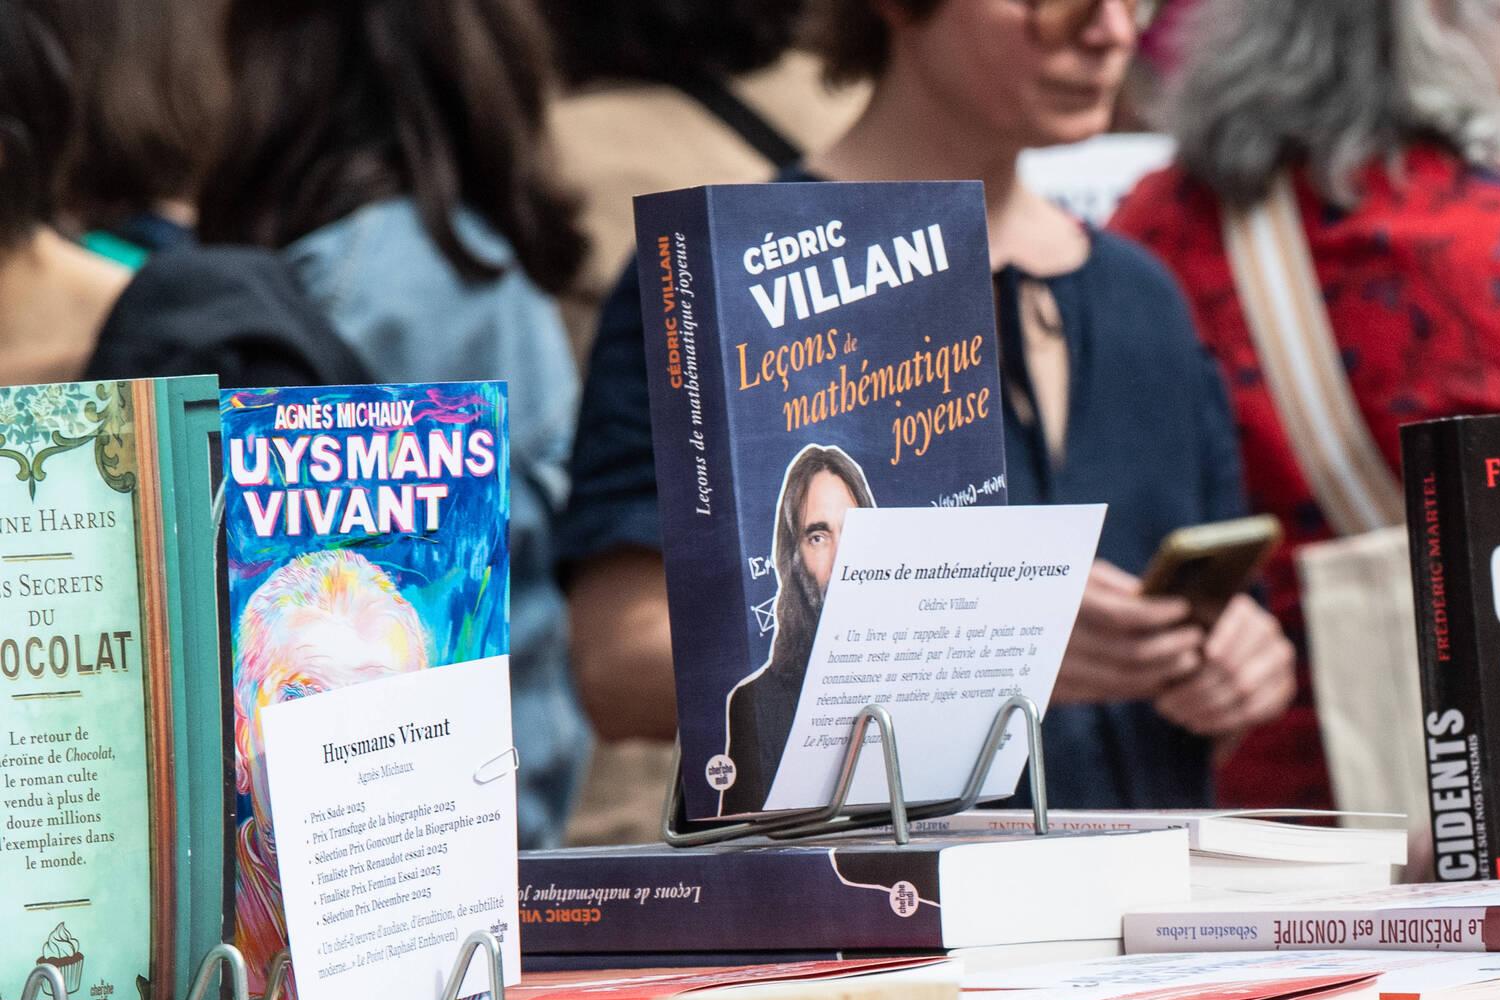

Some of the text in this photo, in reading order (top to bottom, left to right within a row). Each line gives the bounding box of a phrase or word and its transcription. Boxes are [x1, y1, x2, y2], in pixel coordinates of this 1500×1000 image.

[742, 219, 846, 275] CÉDRIC
[750, 223, 950, 328] VILLANI
[658, 236, 683, 389] CÉDRIC VILLANI
[736, 328, 858, 391] Leçons de
[675, 232, 712, 516] Leçons de mathématique joyeuse
[783, 334, 983, 431] mathématique
[275, 398, 415, 430] AGNÈS MICHAUX
[891, 388, 989, 465] joyeuse
[39, 509, 116, 531] HARRIS
[243, 484, 447, 537] VIVANT
[840, 561, 1070, 585] Leçons de mathématique joyeuse
[1423, 472, 1451, 662] FRÉDÉRIC MARTEL
[19, 574, 104, 596] SECRETS
[28, 609, 55, 626] DU
[9, 726, 89, 745] Le retour de
[322, 718, 450, 764] Huysmans Vivant
[48, 749, 62, 764] de
[66, 745, 116, 763] Chocolat,
[5, 767, 98, 788] le roman culte
[4, 787, 101, 810] vendu à plus de
[1426, 708, 1477, 880] CIDENTS
[434, 800, 456, 813] 2025
[6, 810, 101, 830] douze millions
[425, 815, 474, 835] Biographie
[476, 811, 501, 824] 2026
[0, 829, 115, 853] 'exemplaires dans
[26, 851, 86, 870] le monde.
[533, 882, 701, 907] Leçons de mathématique
[546, 908, 601, 926] CÉDRIC
[1352, 918, 1374, 936] est
[1156, 925, 1198, 939] Liebus
[1199, 924, 1258, 940] Sébastien
[1273, 919, 1347, 950] CONSTIPÉ
[1379, 918, 1462, 949] PRÉSIDENT
